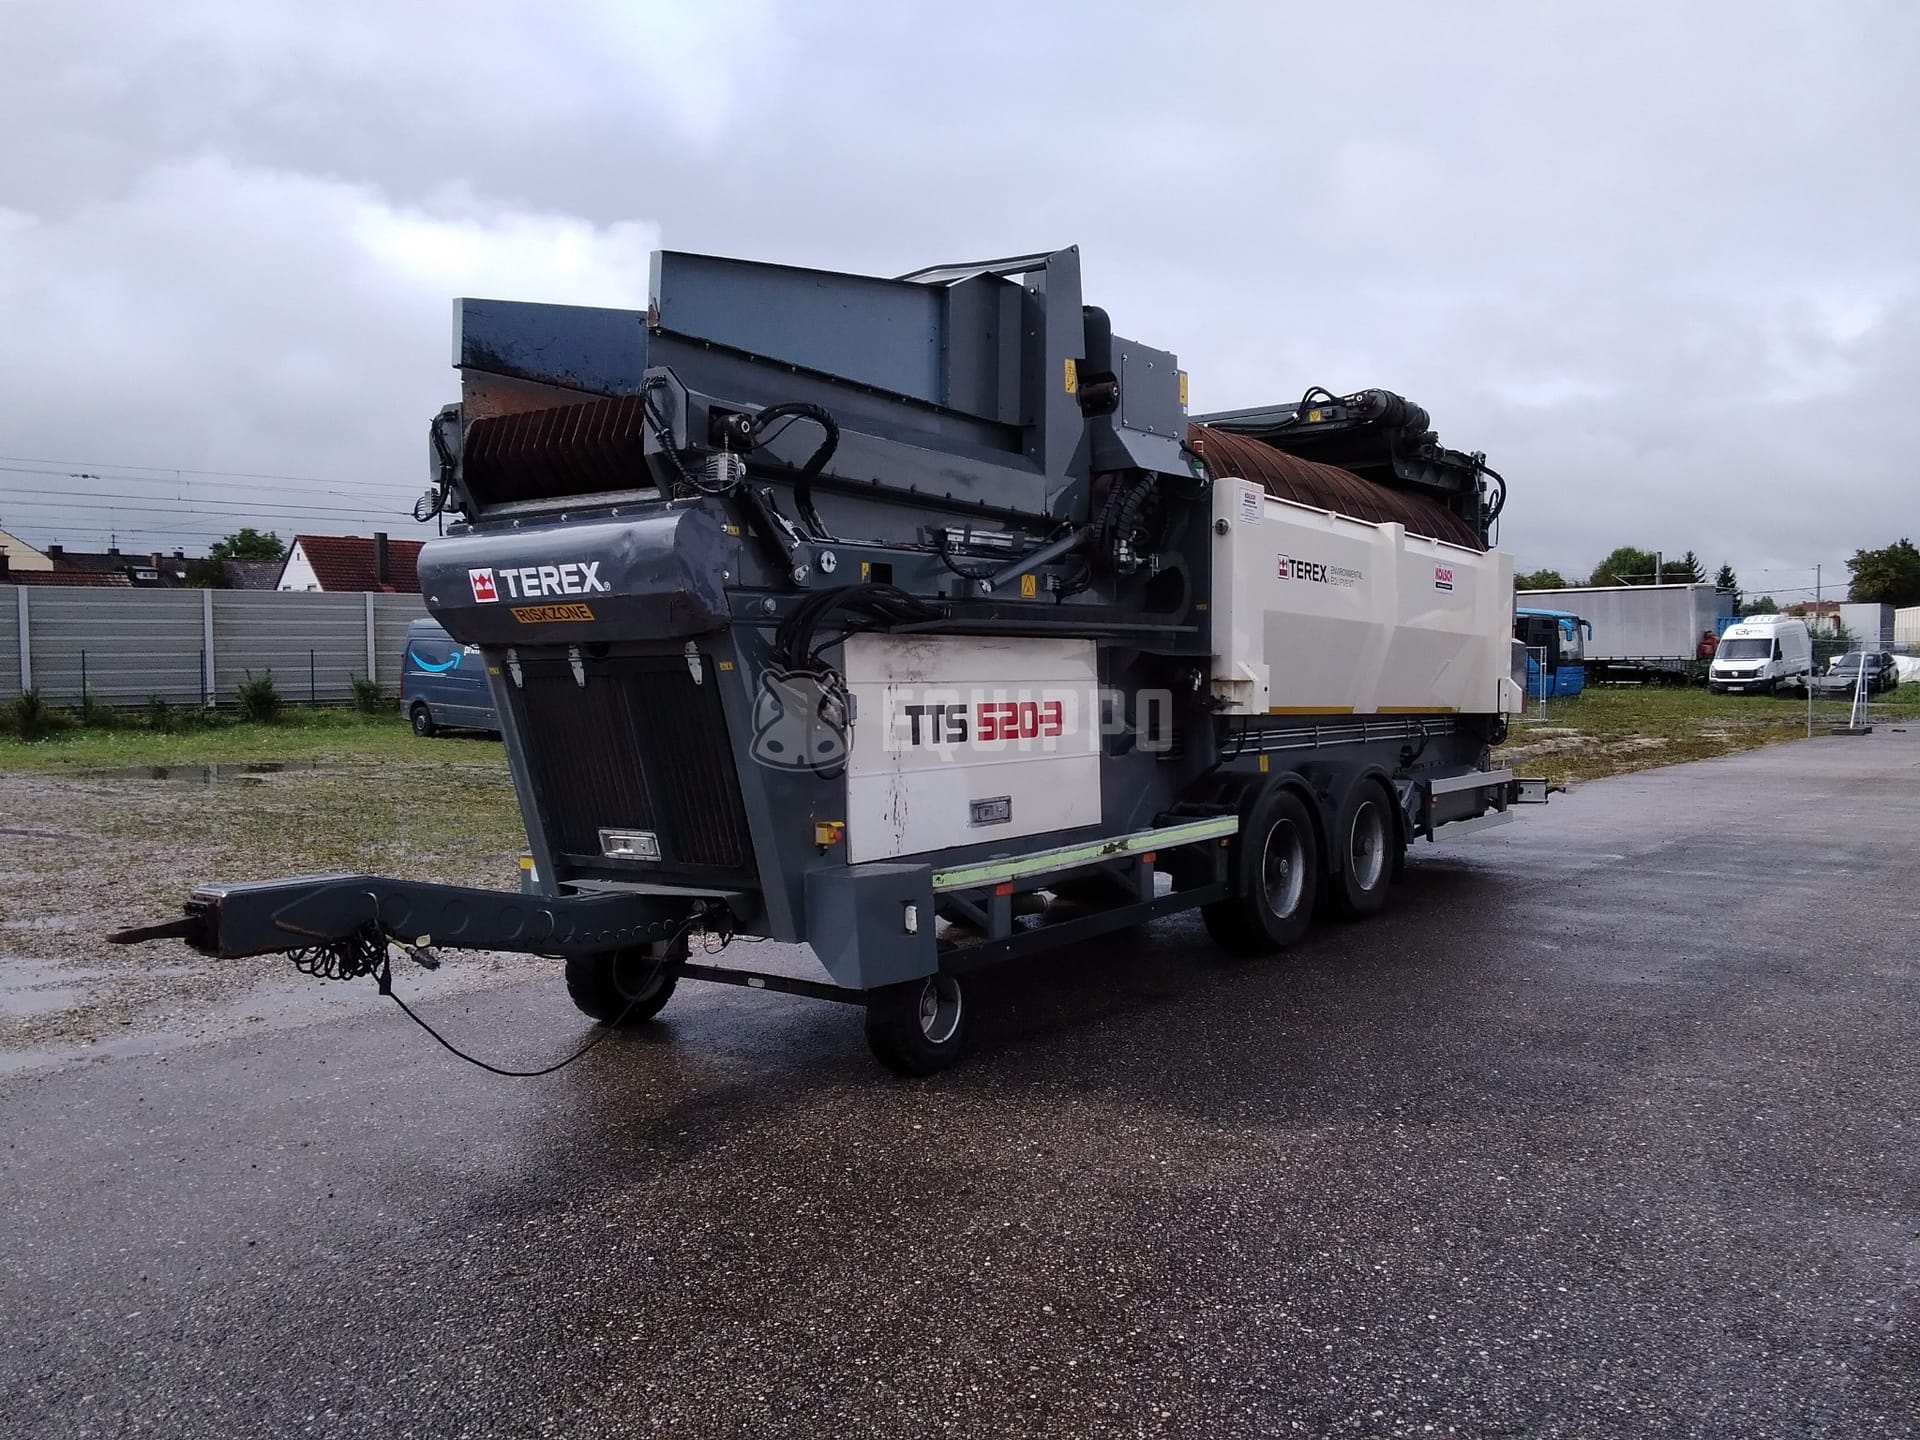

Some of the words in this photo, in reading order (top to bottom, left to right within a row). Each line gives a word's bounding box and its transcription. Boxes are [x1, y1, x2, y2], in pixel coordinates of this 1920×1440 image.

[500, 561, 605, 598] TEREX
[1288, 559, 1328, 584] TEREX
[514, 604, 594, 622] RISKZONE
[905, 704, 968, 745] TTS
